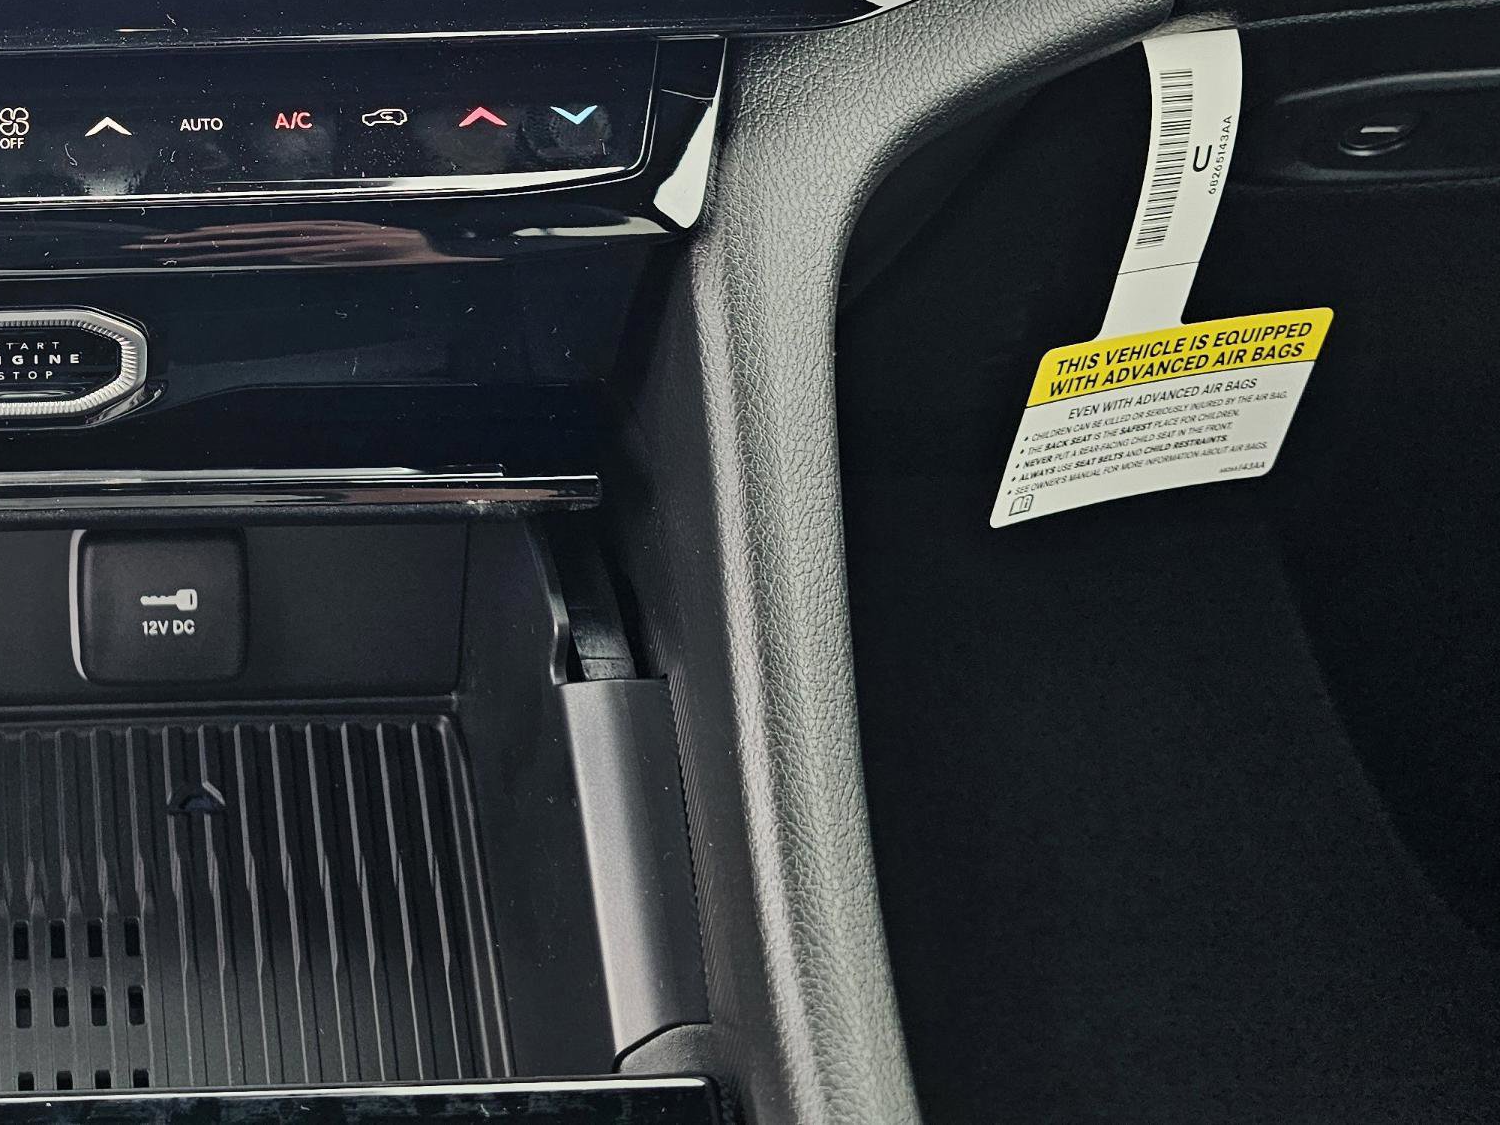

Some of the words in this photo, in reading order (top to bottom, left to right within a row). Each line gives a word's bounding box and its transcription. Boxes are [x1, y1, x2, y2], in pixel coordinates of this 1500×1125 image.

[180, 117, 224, 132] AUTO
[274, 111, 313, 130] A/C
[0, 137, 26, 150] OFF
[1192, 145, 1212, 173] U
[1050, 373, 1098, 397] WITH
[1102, 355, 1210, 386] ADVANCED
[1212, 349, 1247, 367] AIR
[1250, 342, 1306, 362] BAGS
[1056, 352, 1099, 376] THIS
[1105, 339, 1184, 365] VEHICLE
[1189, 334, 1208, 351] IS
[1212, 322, 1312, 347] EQUIPPED
[1032, 426, 1072, 441] CHILDREN
[1072, 422, 1090, 432] CAN
[1092, 419, 1102, 429] BE
[1104, 414, 1131, 426] KILLED
[1132, 411, 1144, 421] OR
[1224, 397, 1236, 405] BY
[1237, 394, 1252, 403] THE
[1255, 393, 1268, 401] AIR
[1068, 404, 1100, 419] EVEN
[1102, 397, 1133, 413] WITH
[1134, 386, 1199, 407] ADVANCED
[1201, 383, 1223, 395] AIR
[1224, 378, 1258, 392] BAGS
[1023, 455, 1052, 469] NEVER
[1054, 451, 1070, 461] PUT
[1130, 433, 1156, 445] CHILD
[1156, 429, 1176, 439] SEAT
[1178, 427, 1186, 436] IN
[1188, 425, 1204, 435] THE
[1028, 446, 1042, 455] THE
[1044, 440, 1069, 451] BACK
[1070, 434, 1092, 445] SEAT
[1094, 432, 1101, 440] IS
[1103, 429, 1119, 438] THE
[1120, 421, 1152, 435] SAFEST
[1153, 417, 1179, 429] PLACE
[1180, 414, 1196, 424] FOR
[1014, 484, 1030, 495] SEE
[1069, 469, 1100, 483] MANUAL
[1102, 464, 1119, 475] FOR
[1121, 459, 1143, 471] MORE
[1146, 450, 1200, 466] INFORMATION
[1201, 445, 1229, 456] ABOUT
[1230, 443, 1244, 453] AIR
[1019, 467, 1056, 481] ALWAYS
[1057, 462, 1074, 473] USE
[1074, 457, 1096, 469] SEAT
[1098, 452, 1124, 465] BELTS
[1126, 448, 1142, 457] AND
[1143, 443, 1171, 455] CHILD
[142, 619, 168, 635] 12V
[173, 619, 196, 635] DC
